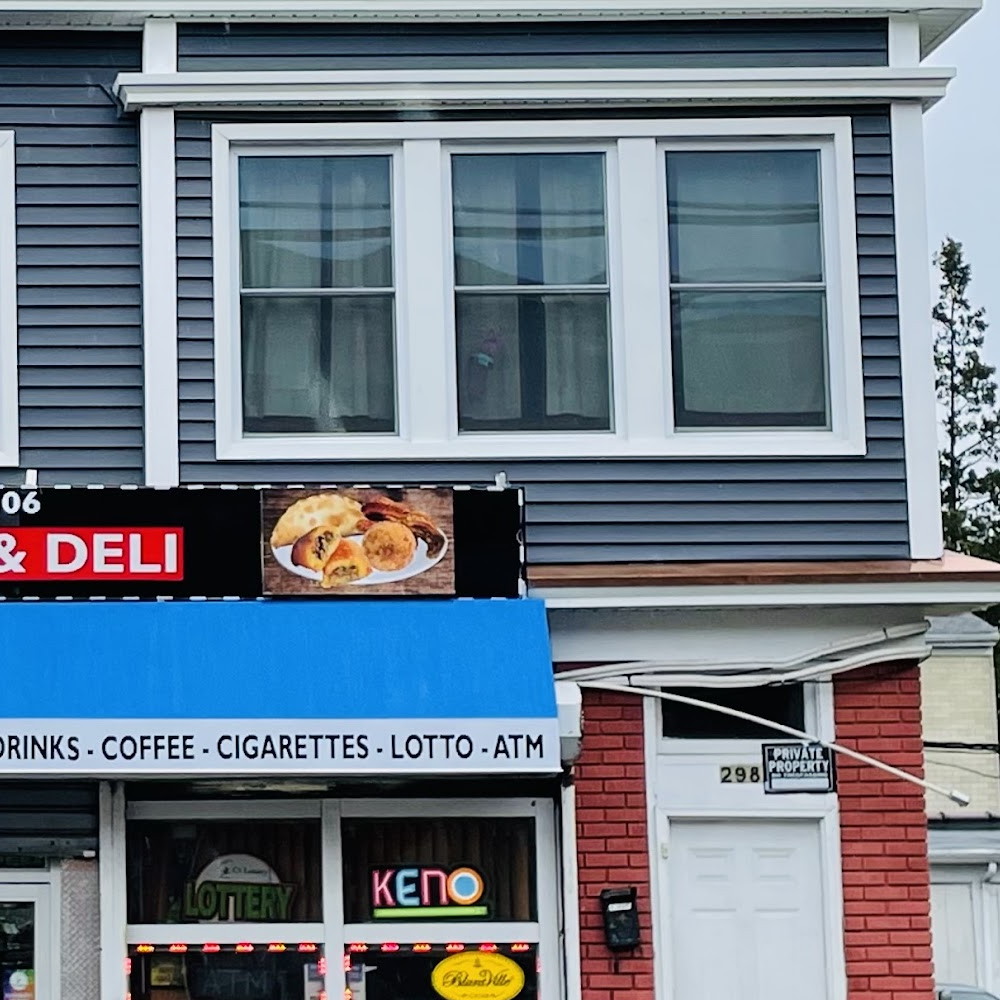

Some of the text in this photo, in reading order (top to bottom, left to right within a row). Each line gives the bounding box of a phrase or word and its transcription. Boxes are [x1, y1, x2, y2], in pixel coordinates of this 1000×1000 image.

[46, 533, 178, 573] DELI
[101, 735, 195, 760] COFFEE
[217, 734, 369, 760] CIGARETTES
[391, 734, 474, 759] LOTTO
[494, 734, 544, 759] ATM
[773, 747, 824, 760] PRIVATE
[720, 766, 760, 783] 298
[769, 760, 829, 772] PROPERTY
[372, 867, 484, 905] KENO
[185, 881, 294, 920] LOTTERY
